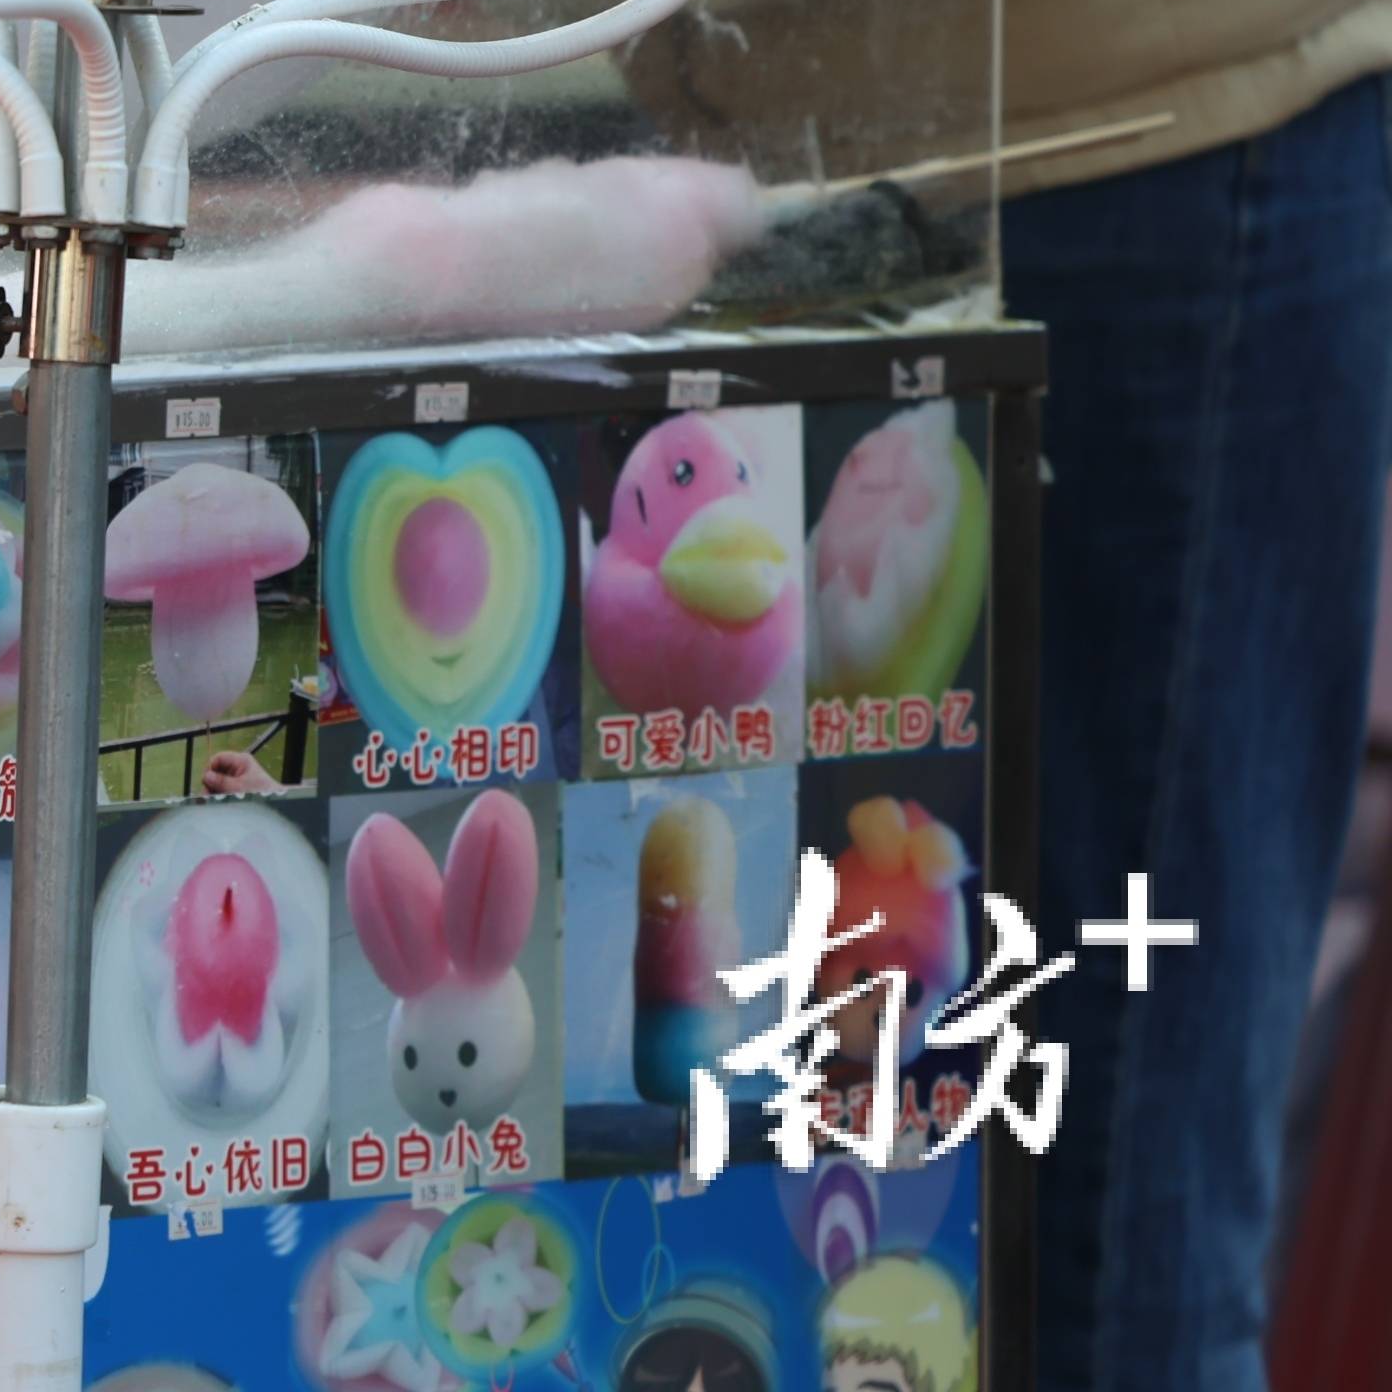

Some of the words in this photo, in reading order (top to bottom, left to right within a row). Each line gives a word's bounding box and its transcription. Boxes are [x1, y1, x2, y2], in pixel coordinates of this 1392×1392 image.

[354, 724, 538, 788] 心心相印
[598, 705, 774, 771] 可爱小鸭
[809, 689, 977, 758] 粉红回忆
[127, 1137, 310, 1205] 吾心依旧
[348, 1119, 528, 1184] 白白小兔
